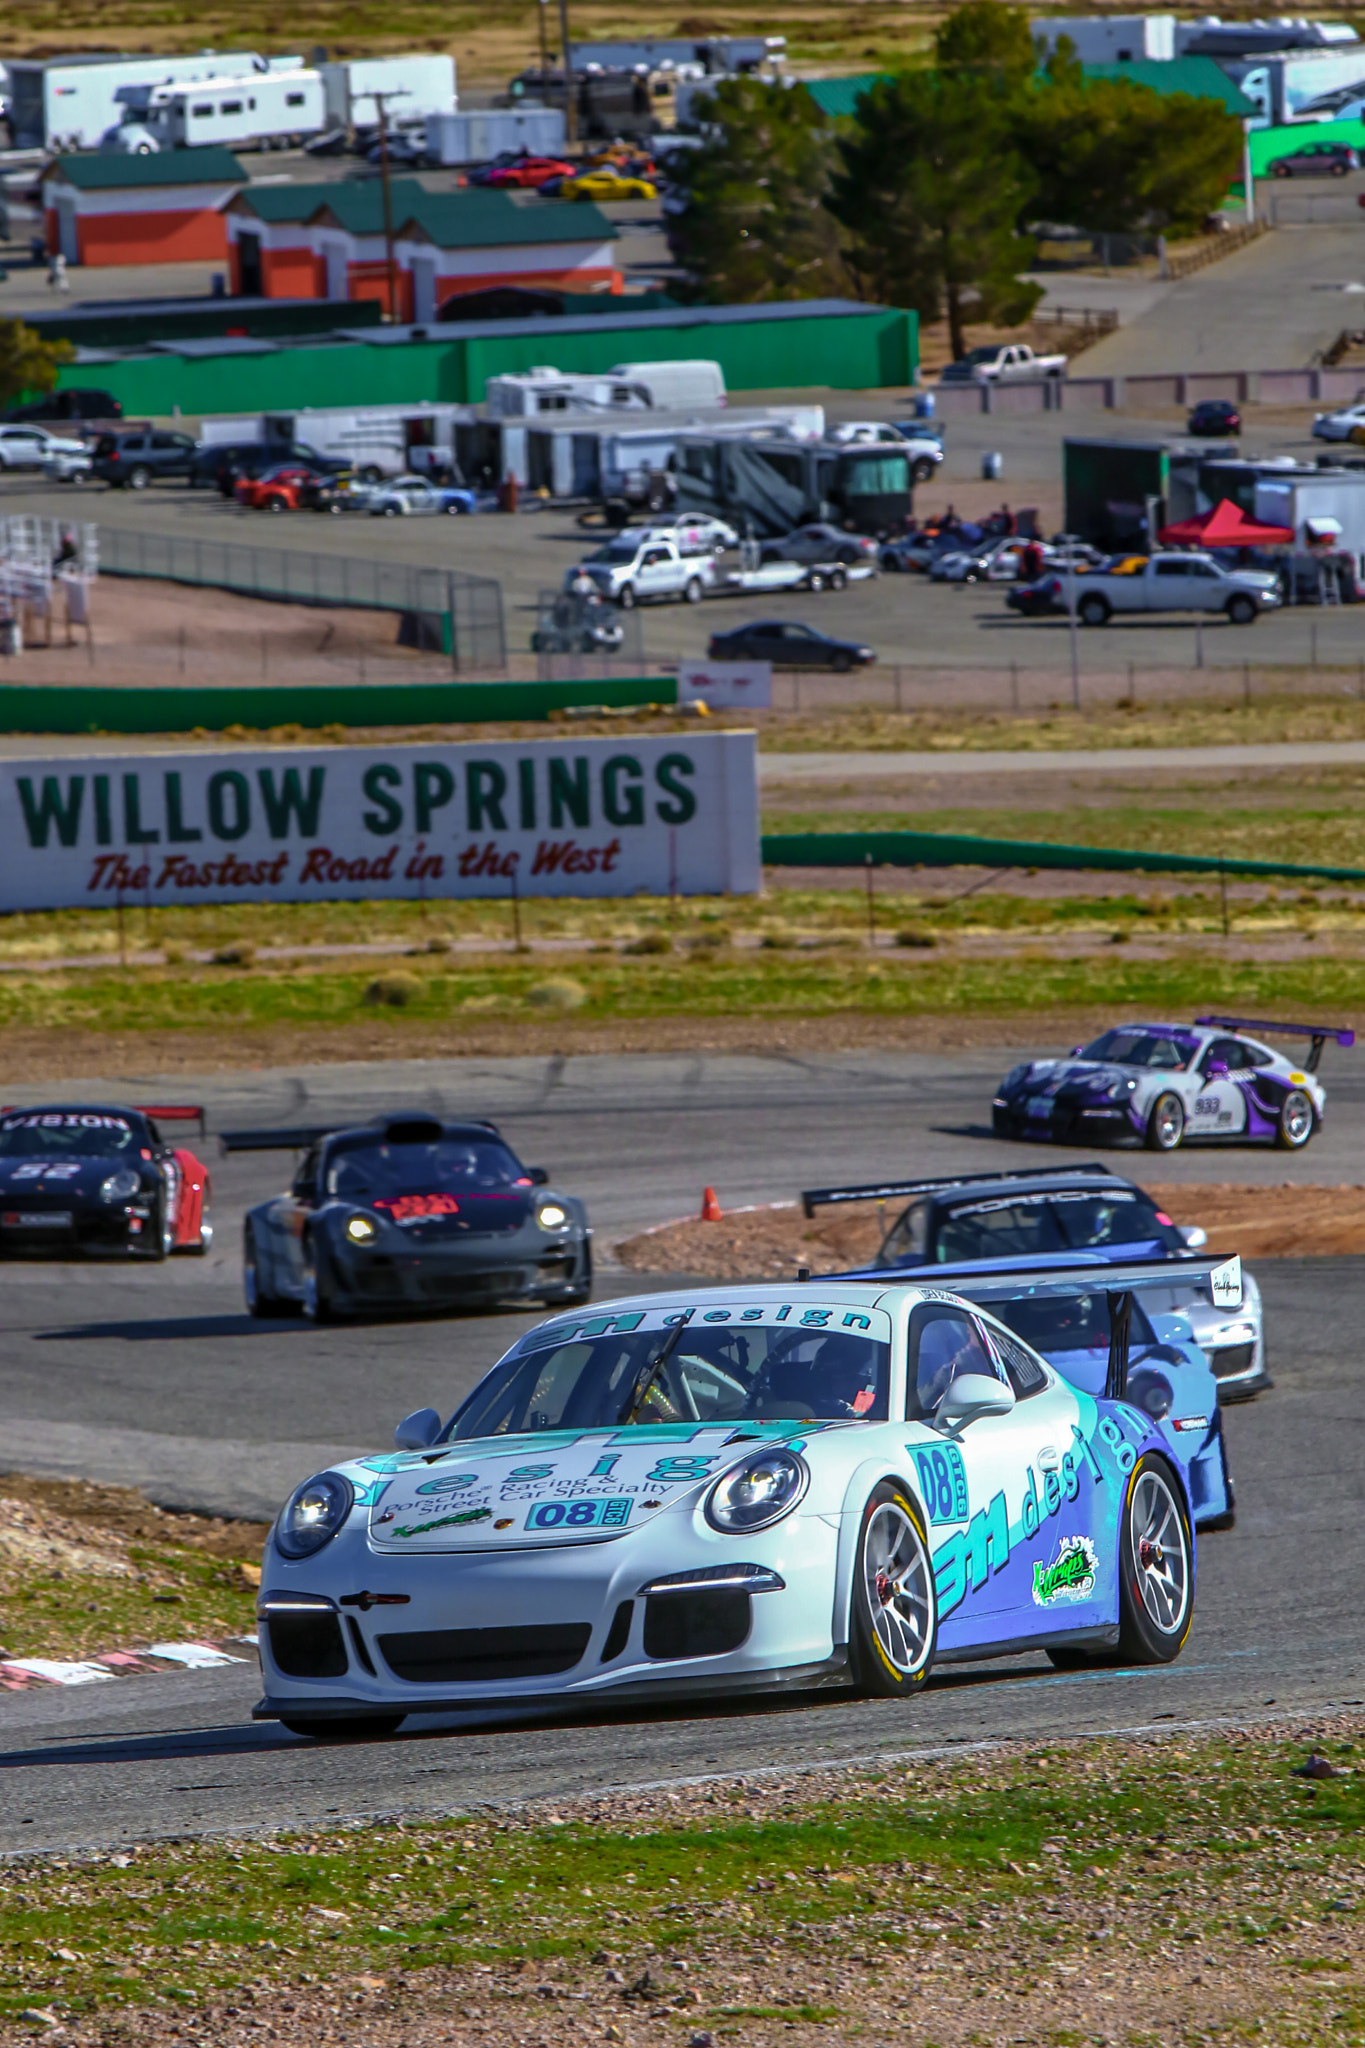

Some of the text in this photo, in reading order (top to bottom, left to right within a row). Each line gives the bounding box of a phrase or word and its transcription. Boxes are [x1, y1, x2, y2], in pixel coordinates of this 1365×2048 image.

[15, 752, 698, 848] WILLOW SPRINGS
[87, 837, 620, 893] The Fastest Road in the West
[2, 1113, 130, 1131] VISION
[10, 1162, 82, 1180] 52
[662, 1303, 873, 1331] design
[499, 1477, 588, 1493] Racing
[597, 1475, 618, 1484] &
[916, 1449, 953, 1520] 08
[417, 1482, 674, 1517] Street Car Specialty
[534, 1501, 600, 1527] 08
